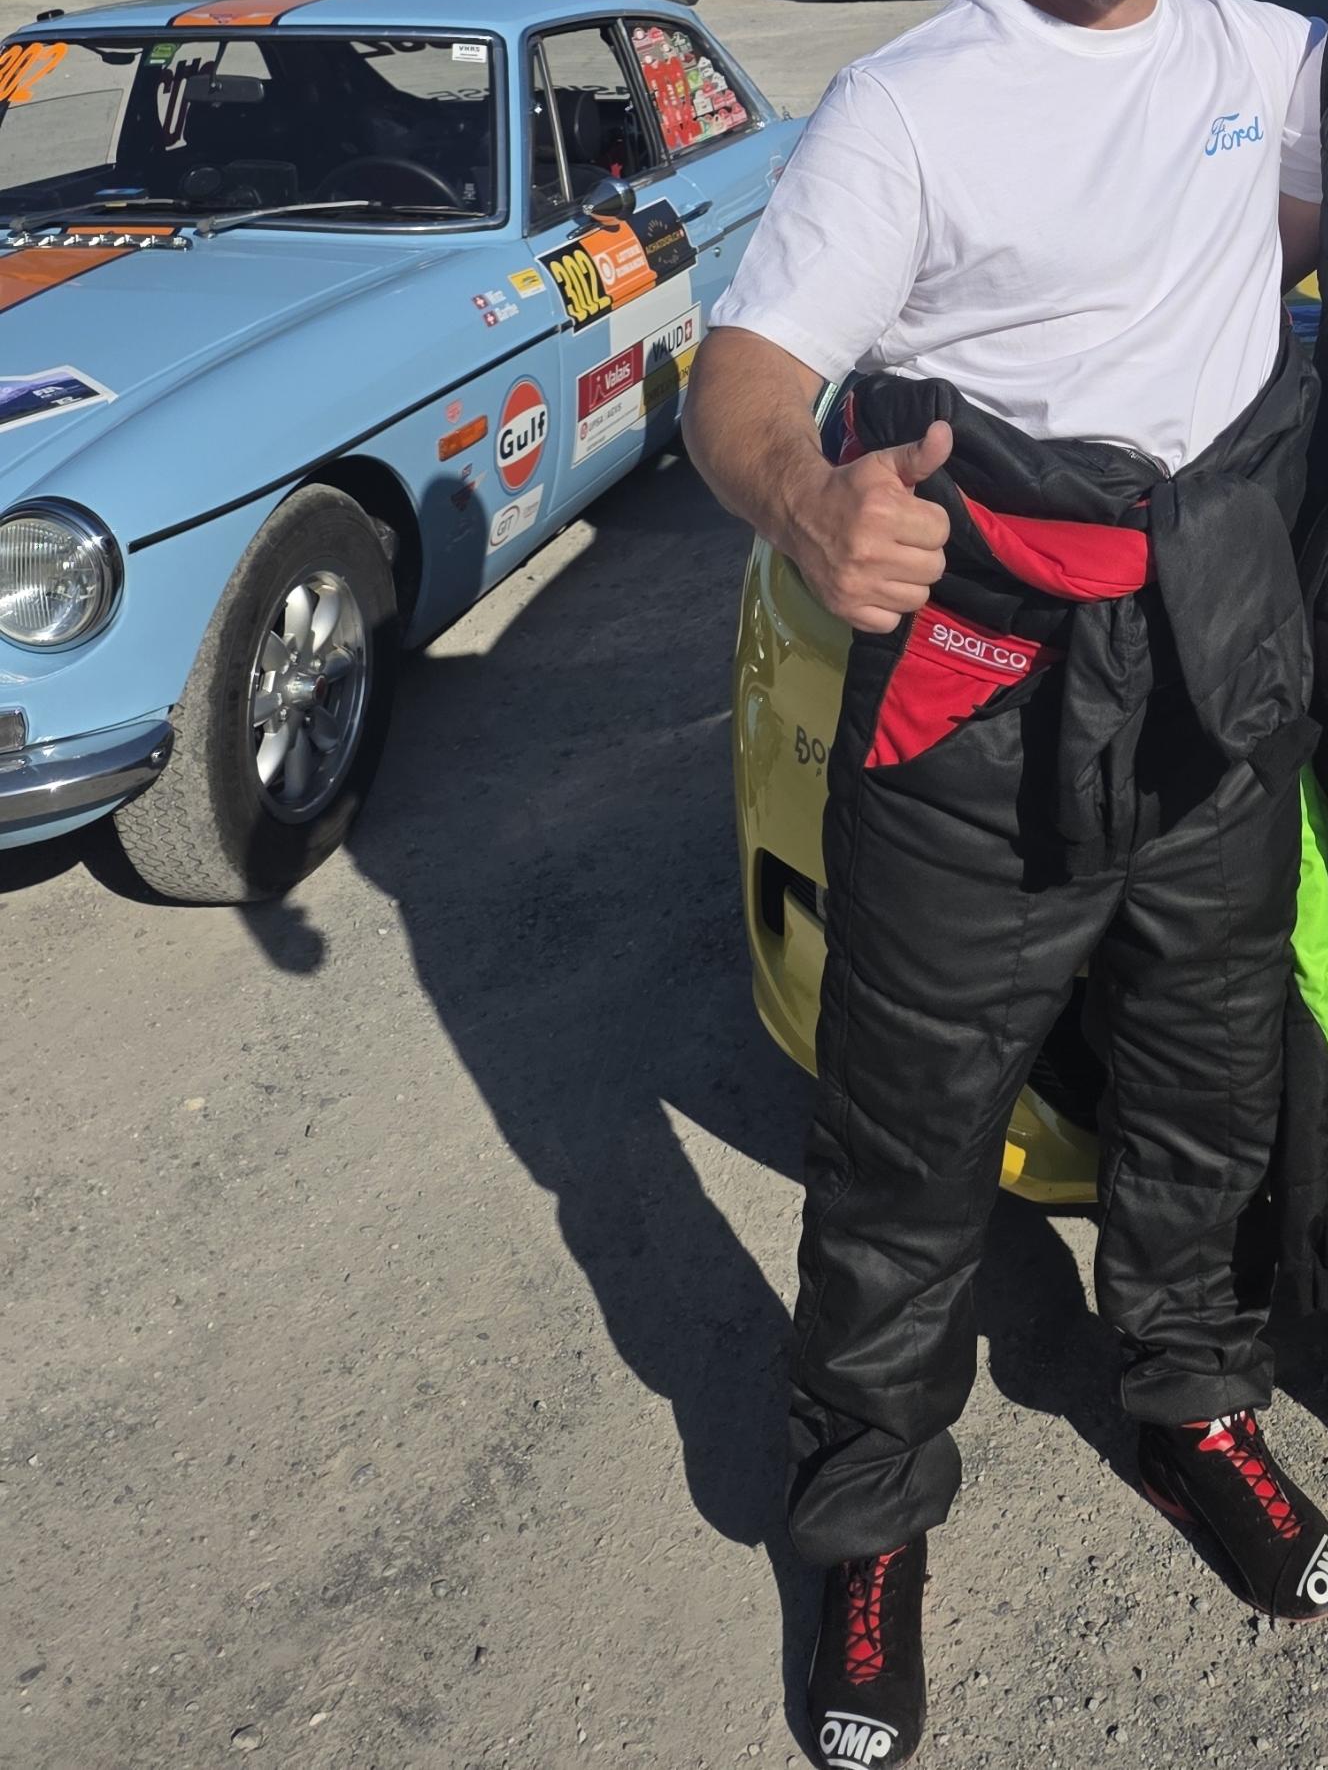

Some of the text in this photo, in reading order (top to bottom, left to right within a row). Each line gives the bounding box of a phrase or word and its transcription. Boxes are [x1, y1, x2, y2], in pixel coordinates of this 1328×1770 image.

[1205, 113, 1263, 156] Ford
[550, 248, 612, 322] 302
[652, 326, 683, 362] VAUD
[604, 360, 631, 390] Valais
[500, 411, 545, 460] Gulf
[933, 624, 1026, 668] sparco
[820, 1720, 892, 1765] OMP
